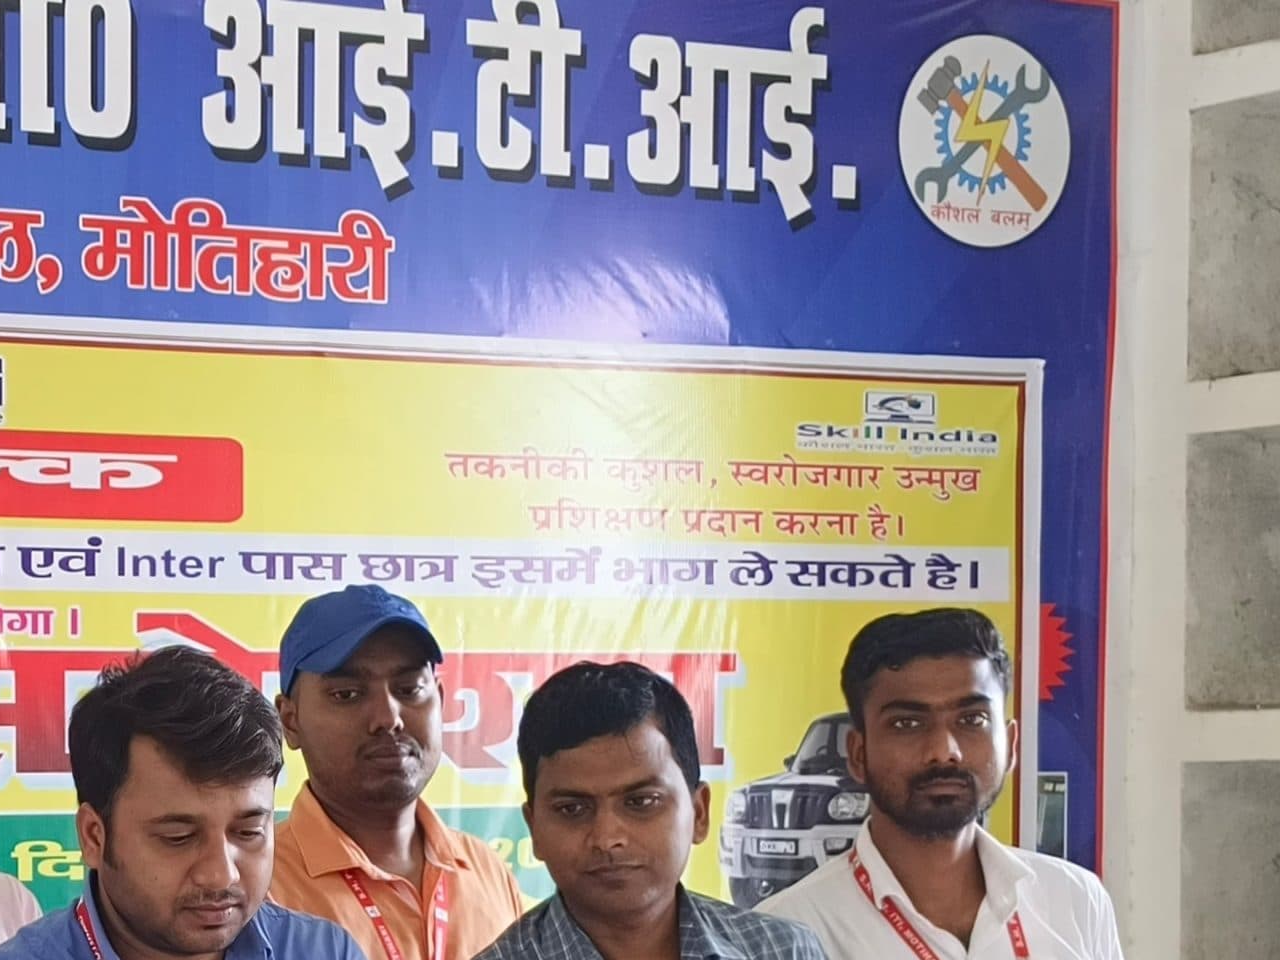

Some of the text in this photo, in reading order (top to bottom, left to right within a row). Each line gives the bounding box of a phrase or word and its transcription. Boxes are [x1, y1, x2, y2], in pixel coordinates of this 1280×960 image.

[80, 197, 395, 304] मोतिहारी
[797, 424, 998, 444] Skill India
[728, 454, 883, 489] स्वरोजगार
[893, 467, 981, 501] उन्मुख
[680, 509, 763, 536] प्रदान
[773, 511, 858, 536] करना
[18, 536, 103, 580] एवं
[117, 546, 225, 580] Inter
[238, 550, 348, 581] पास
[357, 553, 458, 583] छात्र
[470, 547, 602, 589] इसमें
[613, 558, 719, 586] भाग
[728, 551, 778, 588] ले
[785, 554, 915, 589] सकते
